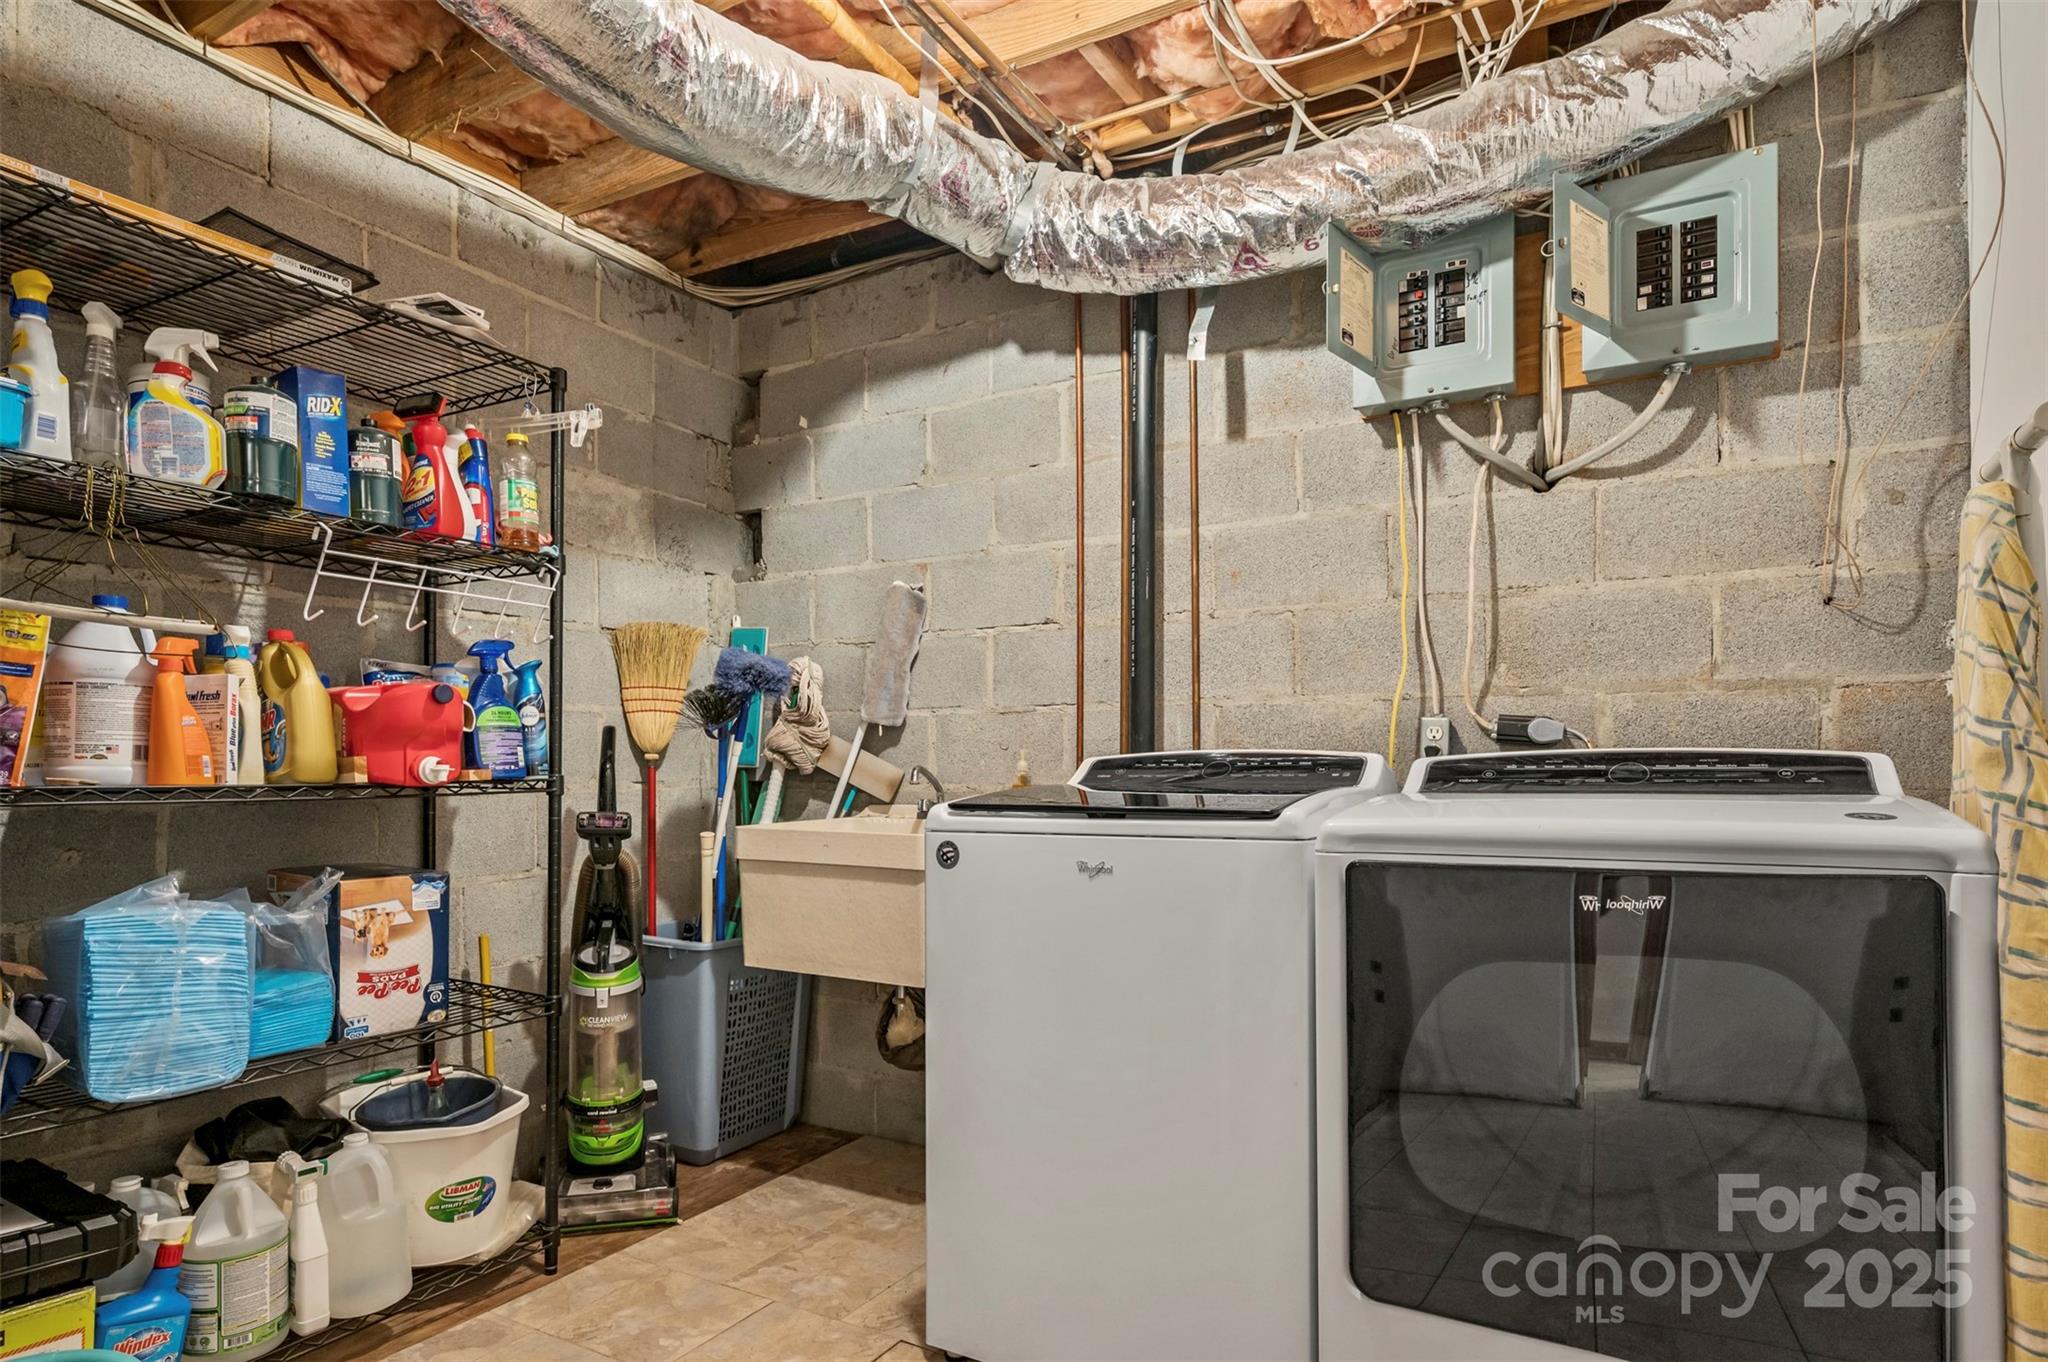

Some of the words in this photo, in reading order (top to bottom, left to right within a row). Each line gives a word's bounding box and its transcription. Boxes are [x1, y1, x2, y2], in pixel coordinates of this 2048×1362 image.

[299, 263, 339, 282] MAXIMUM
[306, 396, 342, 416] RID-X
[230, 693, 238, 717] Borax
[371, 970, 406, 983] PADS
[357, 982, 389, 1000] Pee
[391, 976, 421, 997] Pee
[445, 1181, 481, 1195] LIBMAN
[114, 1331, 171, 1355] Windex
